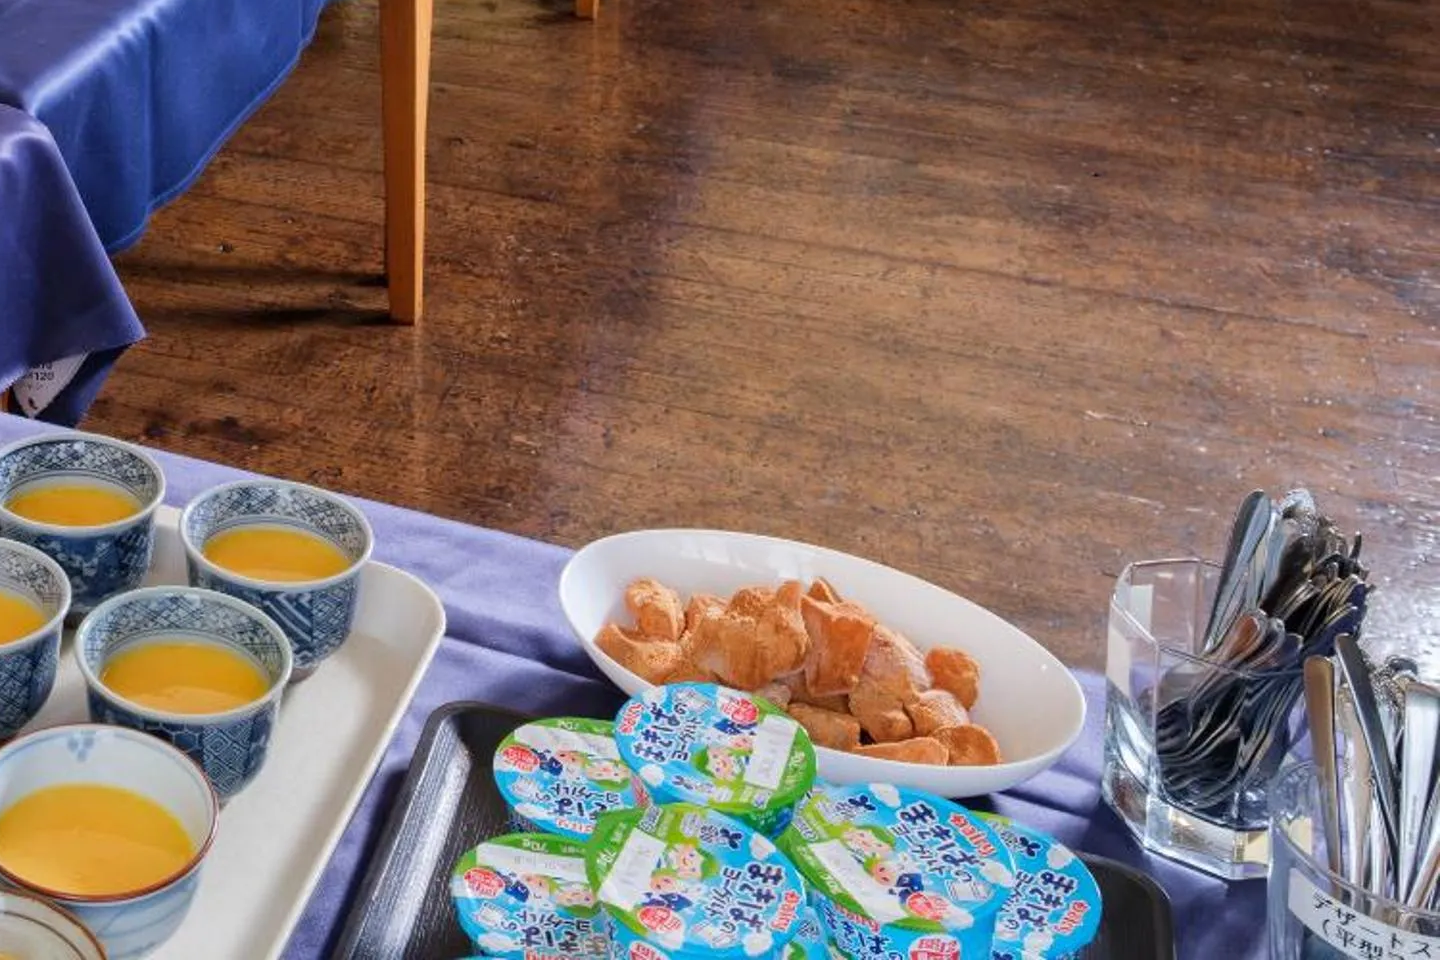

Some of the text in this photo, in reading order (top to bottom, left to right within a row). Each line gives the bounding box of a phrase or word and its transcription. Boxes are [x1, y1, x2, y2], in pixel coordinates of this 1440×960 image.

[1311, 891, 1440, 958] デザートス
